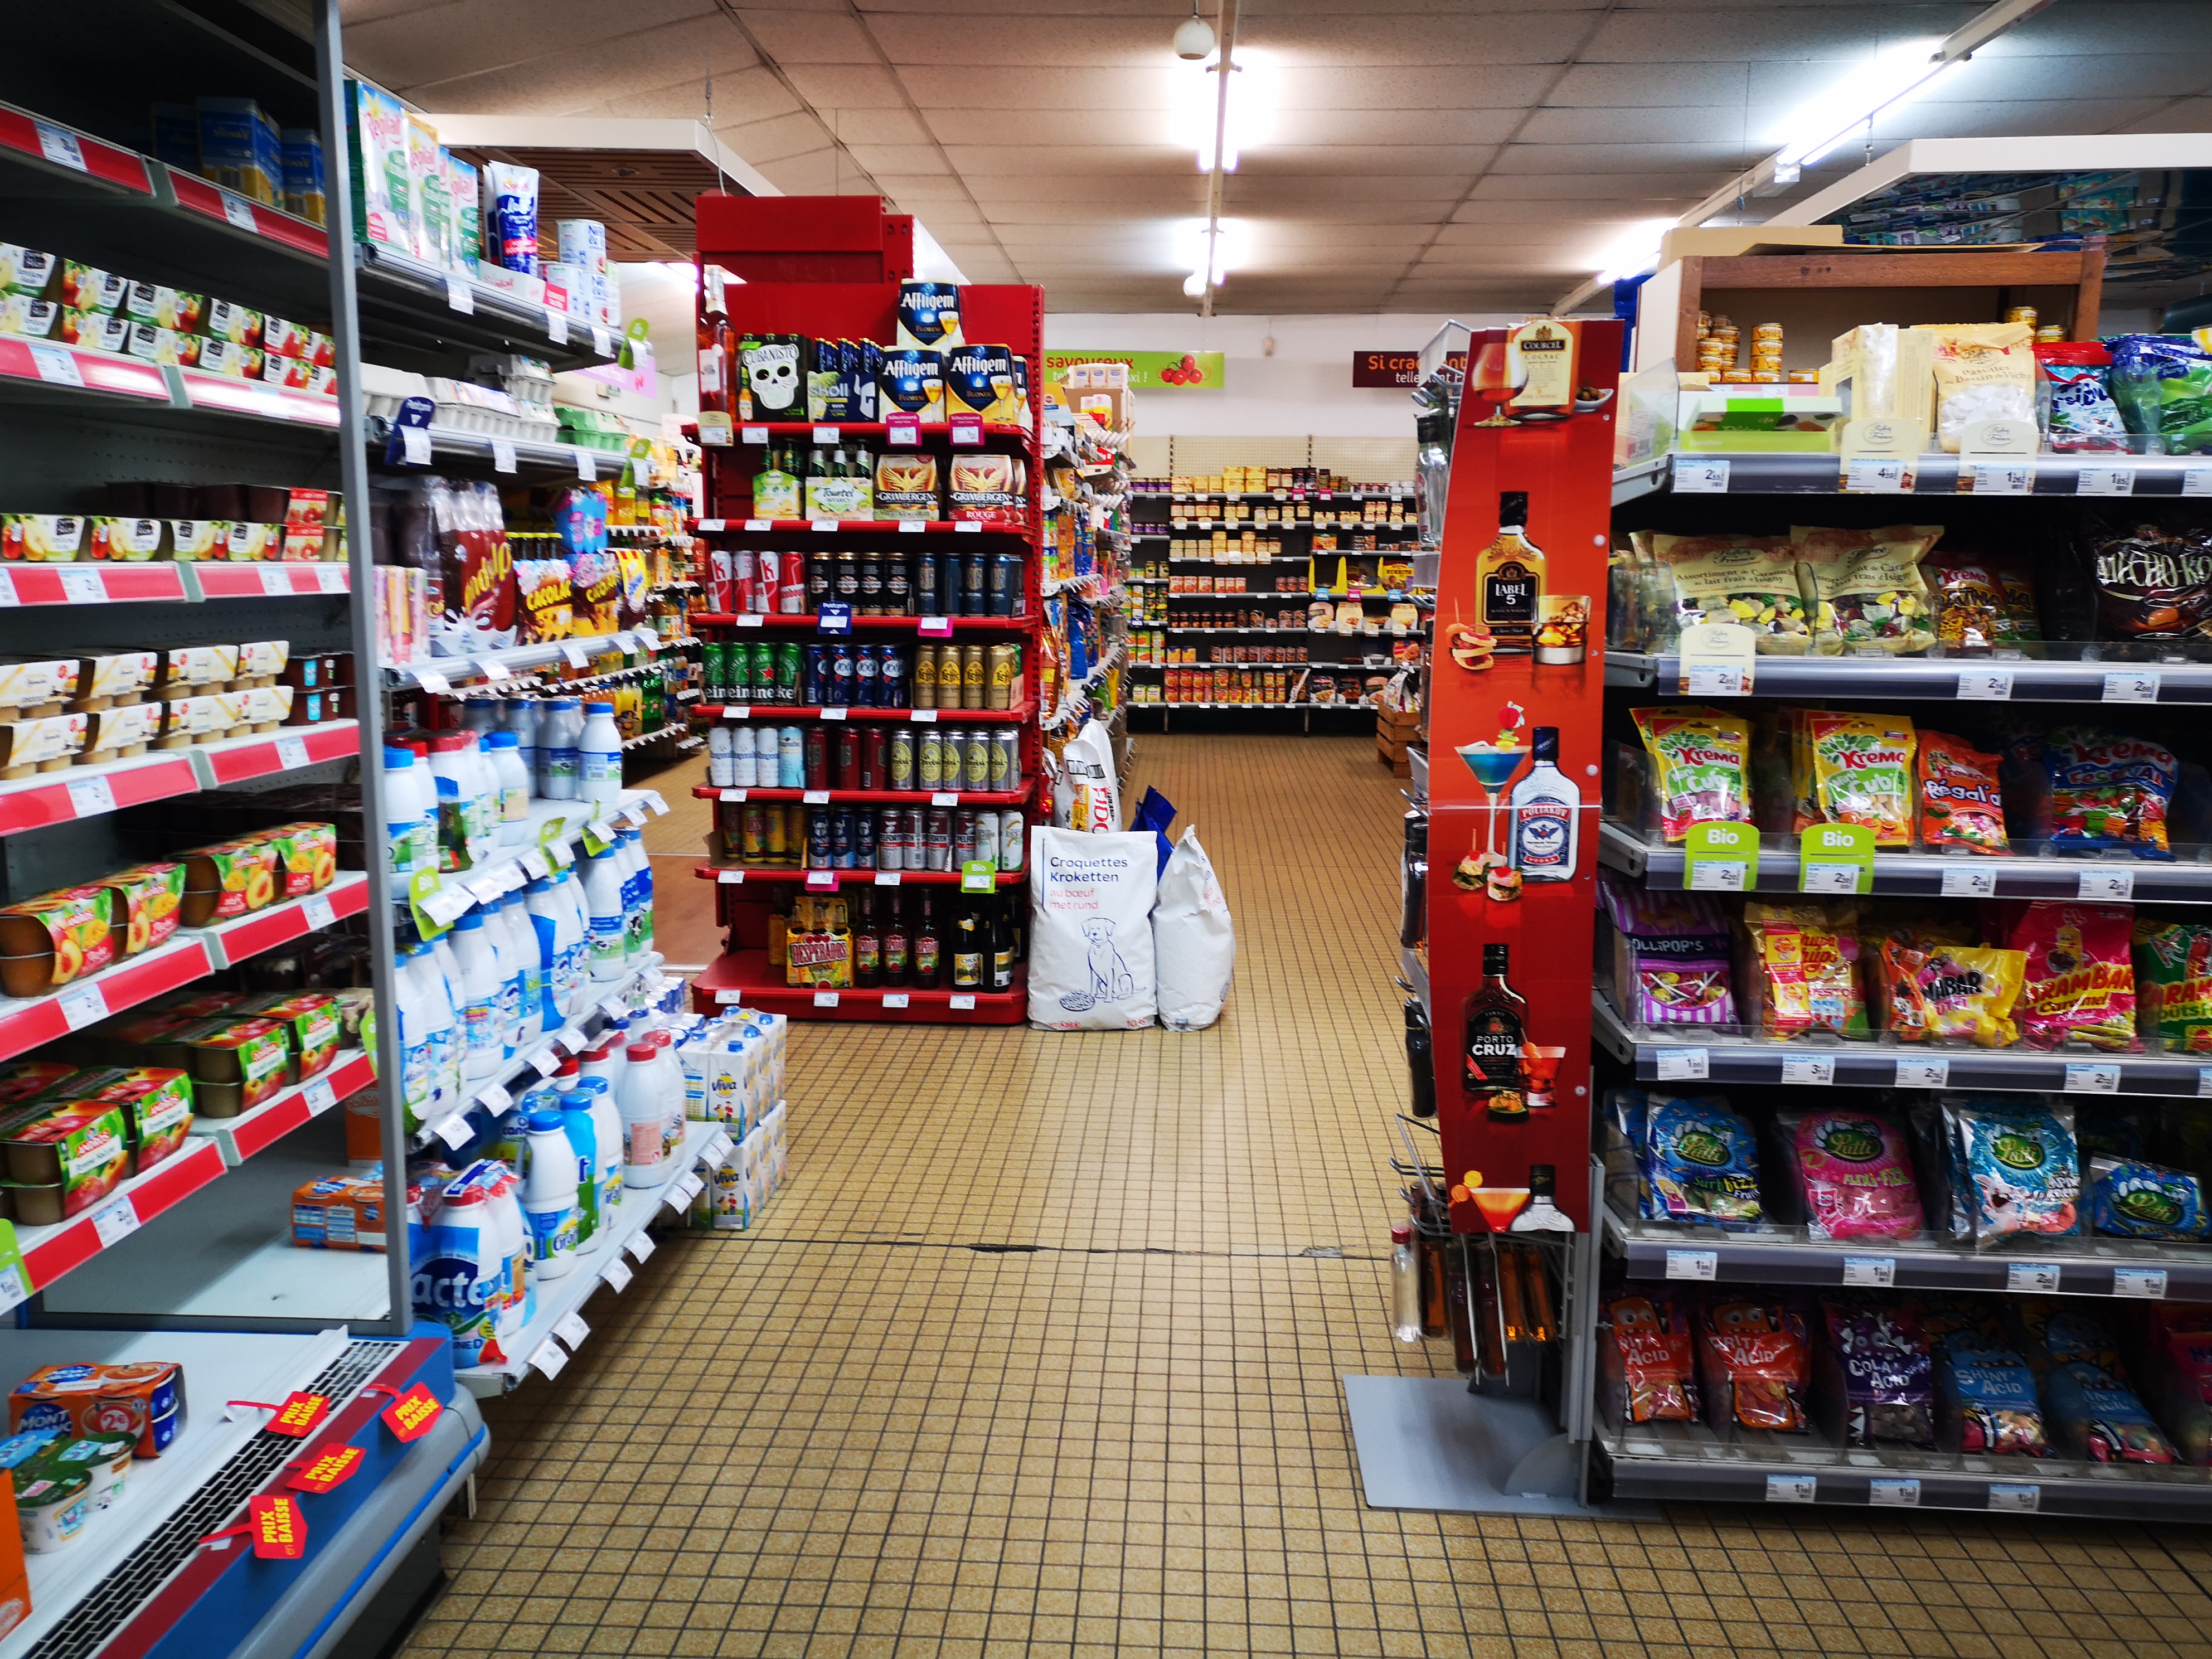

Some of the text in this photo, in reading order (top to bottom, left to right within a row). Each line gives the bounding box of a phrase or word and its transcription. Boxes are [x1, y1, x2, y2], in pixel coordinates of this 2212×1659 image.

[900, 292, 954, 311] Affligem
[1524, 341, 1563, 350] COURCEL
[743, 342, 799, 366] CUBANISTO
[883, 360, 939, 379] Affligem
[950, 356, 1007, 376] Affligem
[1369, 355, 1385, 370] Si
[879, 492, 934, 502] GRIMBERGEN
[954, 492, 1009, 502] GRIMBERGEN
[1676, 569, 1738, 581] Assortiment
[1495, 583, 1529, 596] LABEL
[1506, 594, 1516, 605] 5
[1707, 828, 1739, 845] Bio
[1822, 831, 1855, 847] Bio
[971, 864, 987, 872] Bio
[1050, 857, 1128, 870] Croquettes
[1050, 871, 1119, 882] Kroketten
[1050, 887, 1095, 898] au bœuf
[1050, 900, 1099, 910] met rund
[1801, 933, 1836, 950] hupa
[792, 940, 848, 966] DESPERADOS
[1801, 948, 1838, 963] hups
[1477, 1035, 1514, 1044] PORTO
[1472, 1044, 1516, 1056] CRUZ
[1628, 1348, 1670, 1366] ACID
[1734, 1347, 1775, 1367] ACID
[1870, 1371, 1910, 1389] ACID
[1982, 1380, 2023, 1395] ACID
[280, 1401, 304, 1424] PRIX
[395, 1395, 423, 1421] PRIX
[20, 1409, 71, 1429] MONT
[304, 1455, 338, 1481] PRIX
[260, 1511, 278, 1543] PRIX
